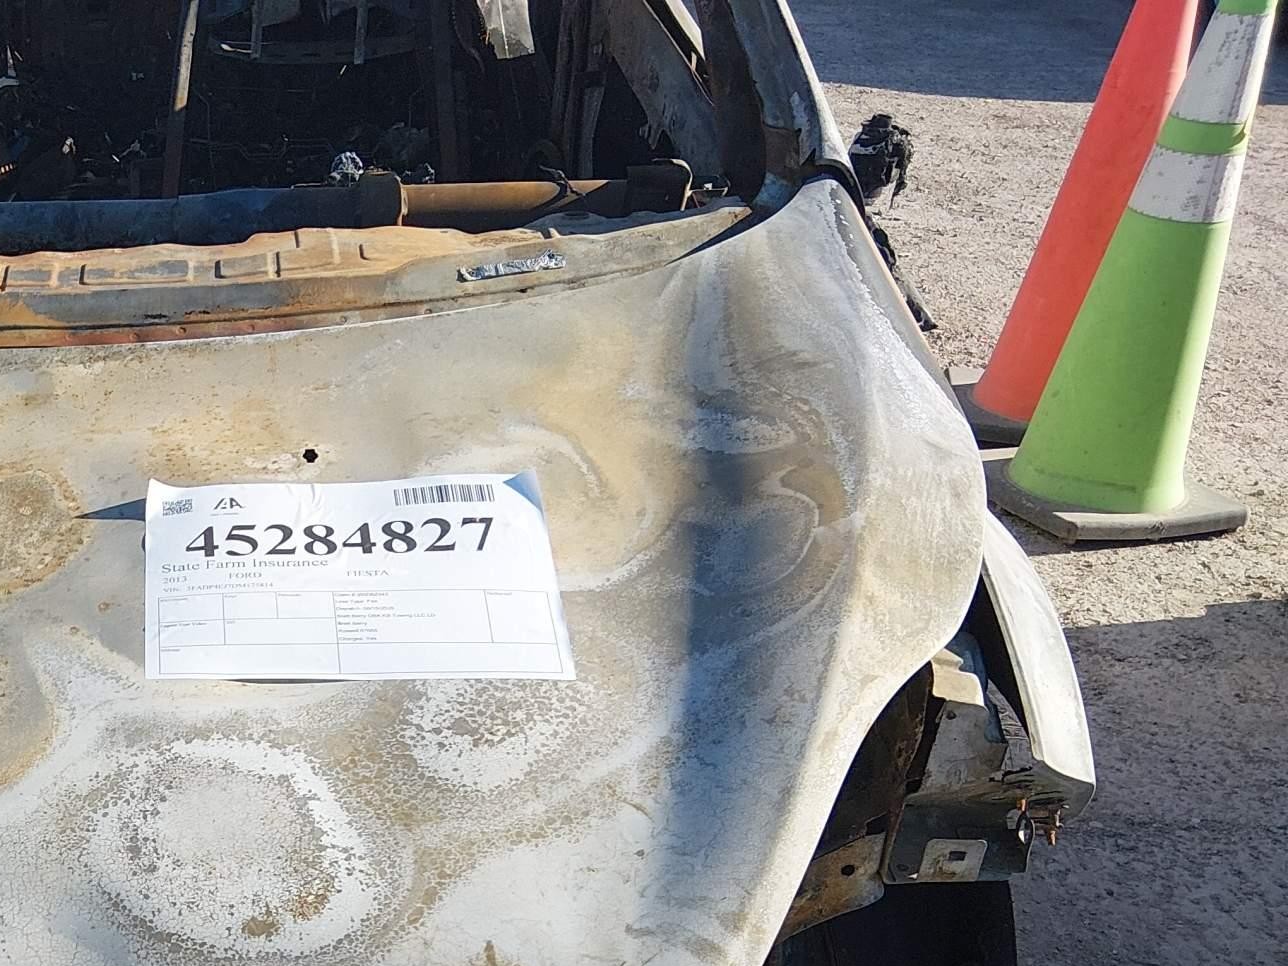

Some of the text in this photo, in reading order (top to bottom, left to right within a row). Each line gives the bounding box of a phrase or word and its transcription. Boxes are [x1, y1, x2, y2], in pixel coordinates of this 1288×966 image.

[185, 517, 494, 557] 45284827
[161, 557, 329, 574] State Farm Insurance
[162, 569, 389, 585] 2013 FORD FIESTA
